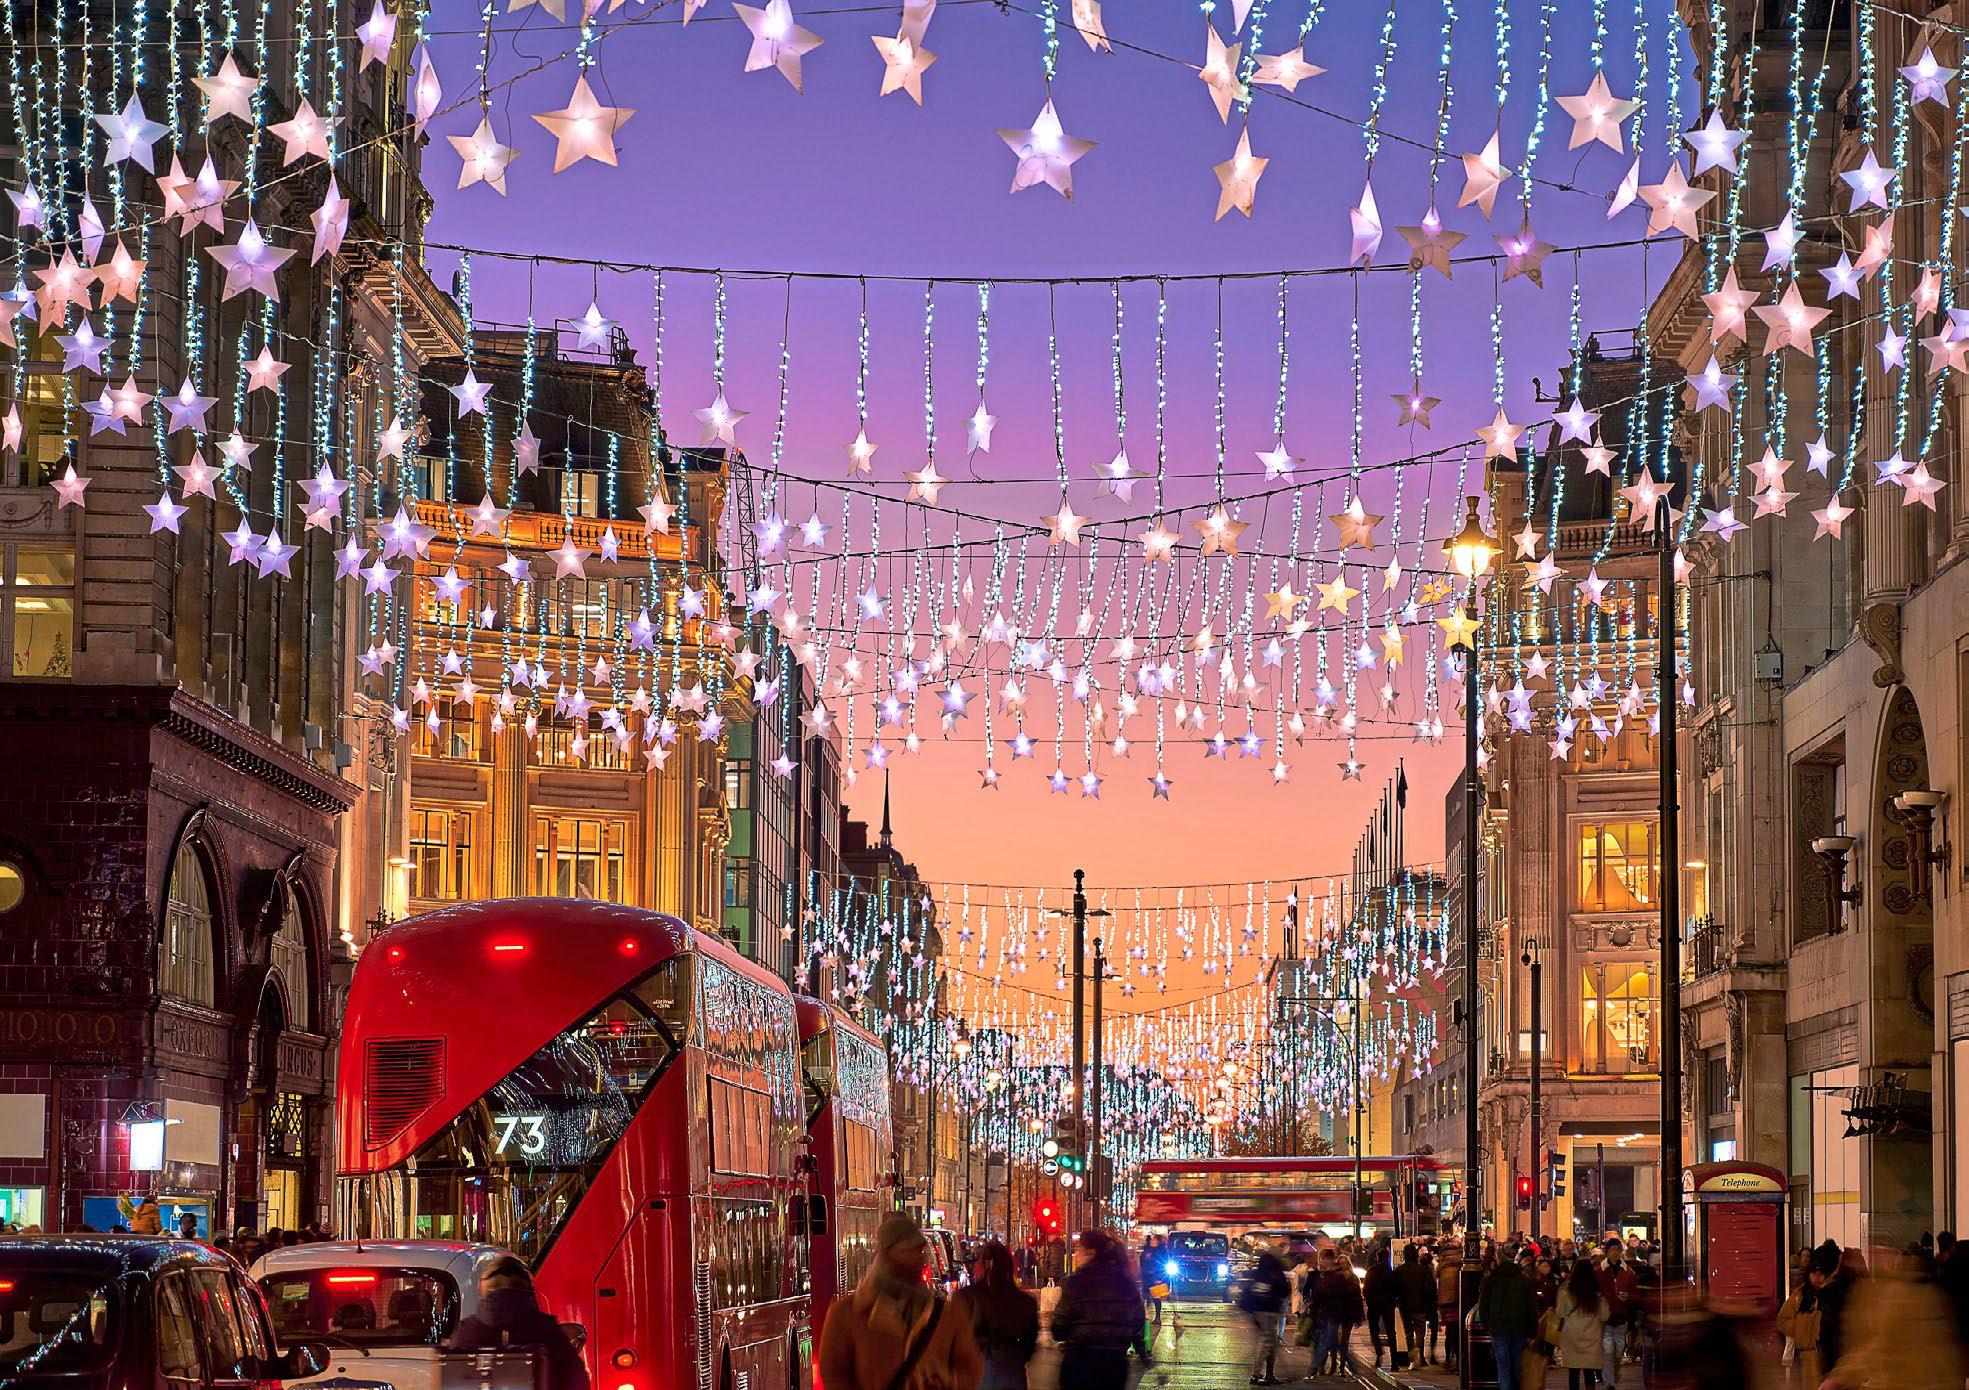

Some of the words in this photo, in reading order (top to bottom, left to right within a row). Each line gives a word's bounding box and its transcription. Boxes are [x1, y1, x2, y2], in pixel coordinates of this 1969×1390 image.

[171, 1018, 219, 1057] OXFORD
[494, 1116, 545, 1154] 73
[1721, 1178, 1761, 1188] Telephone
